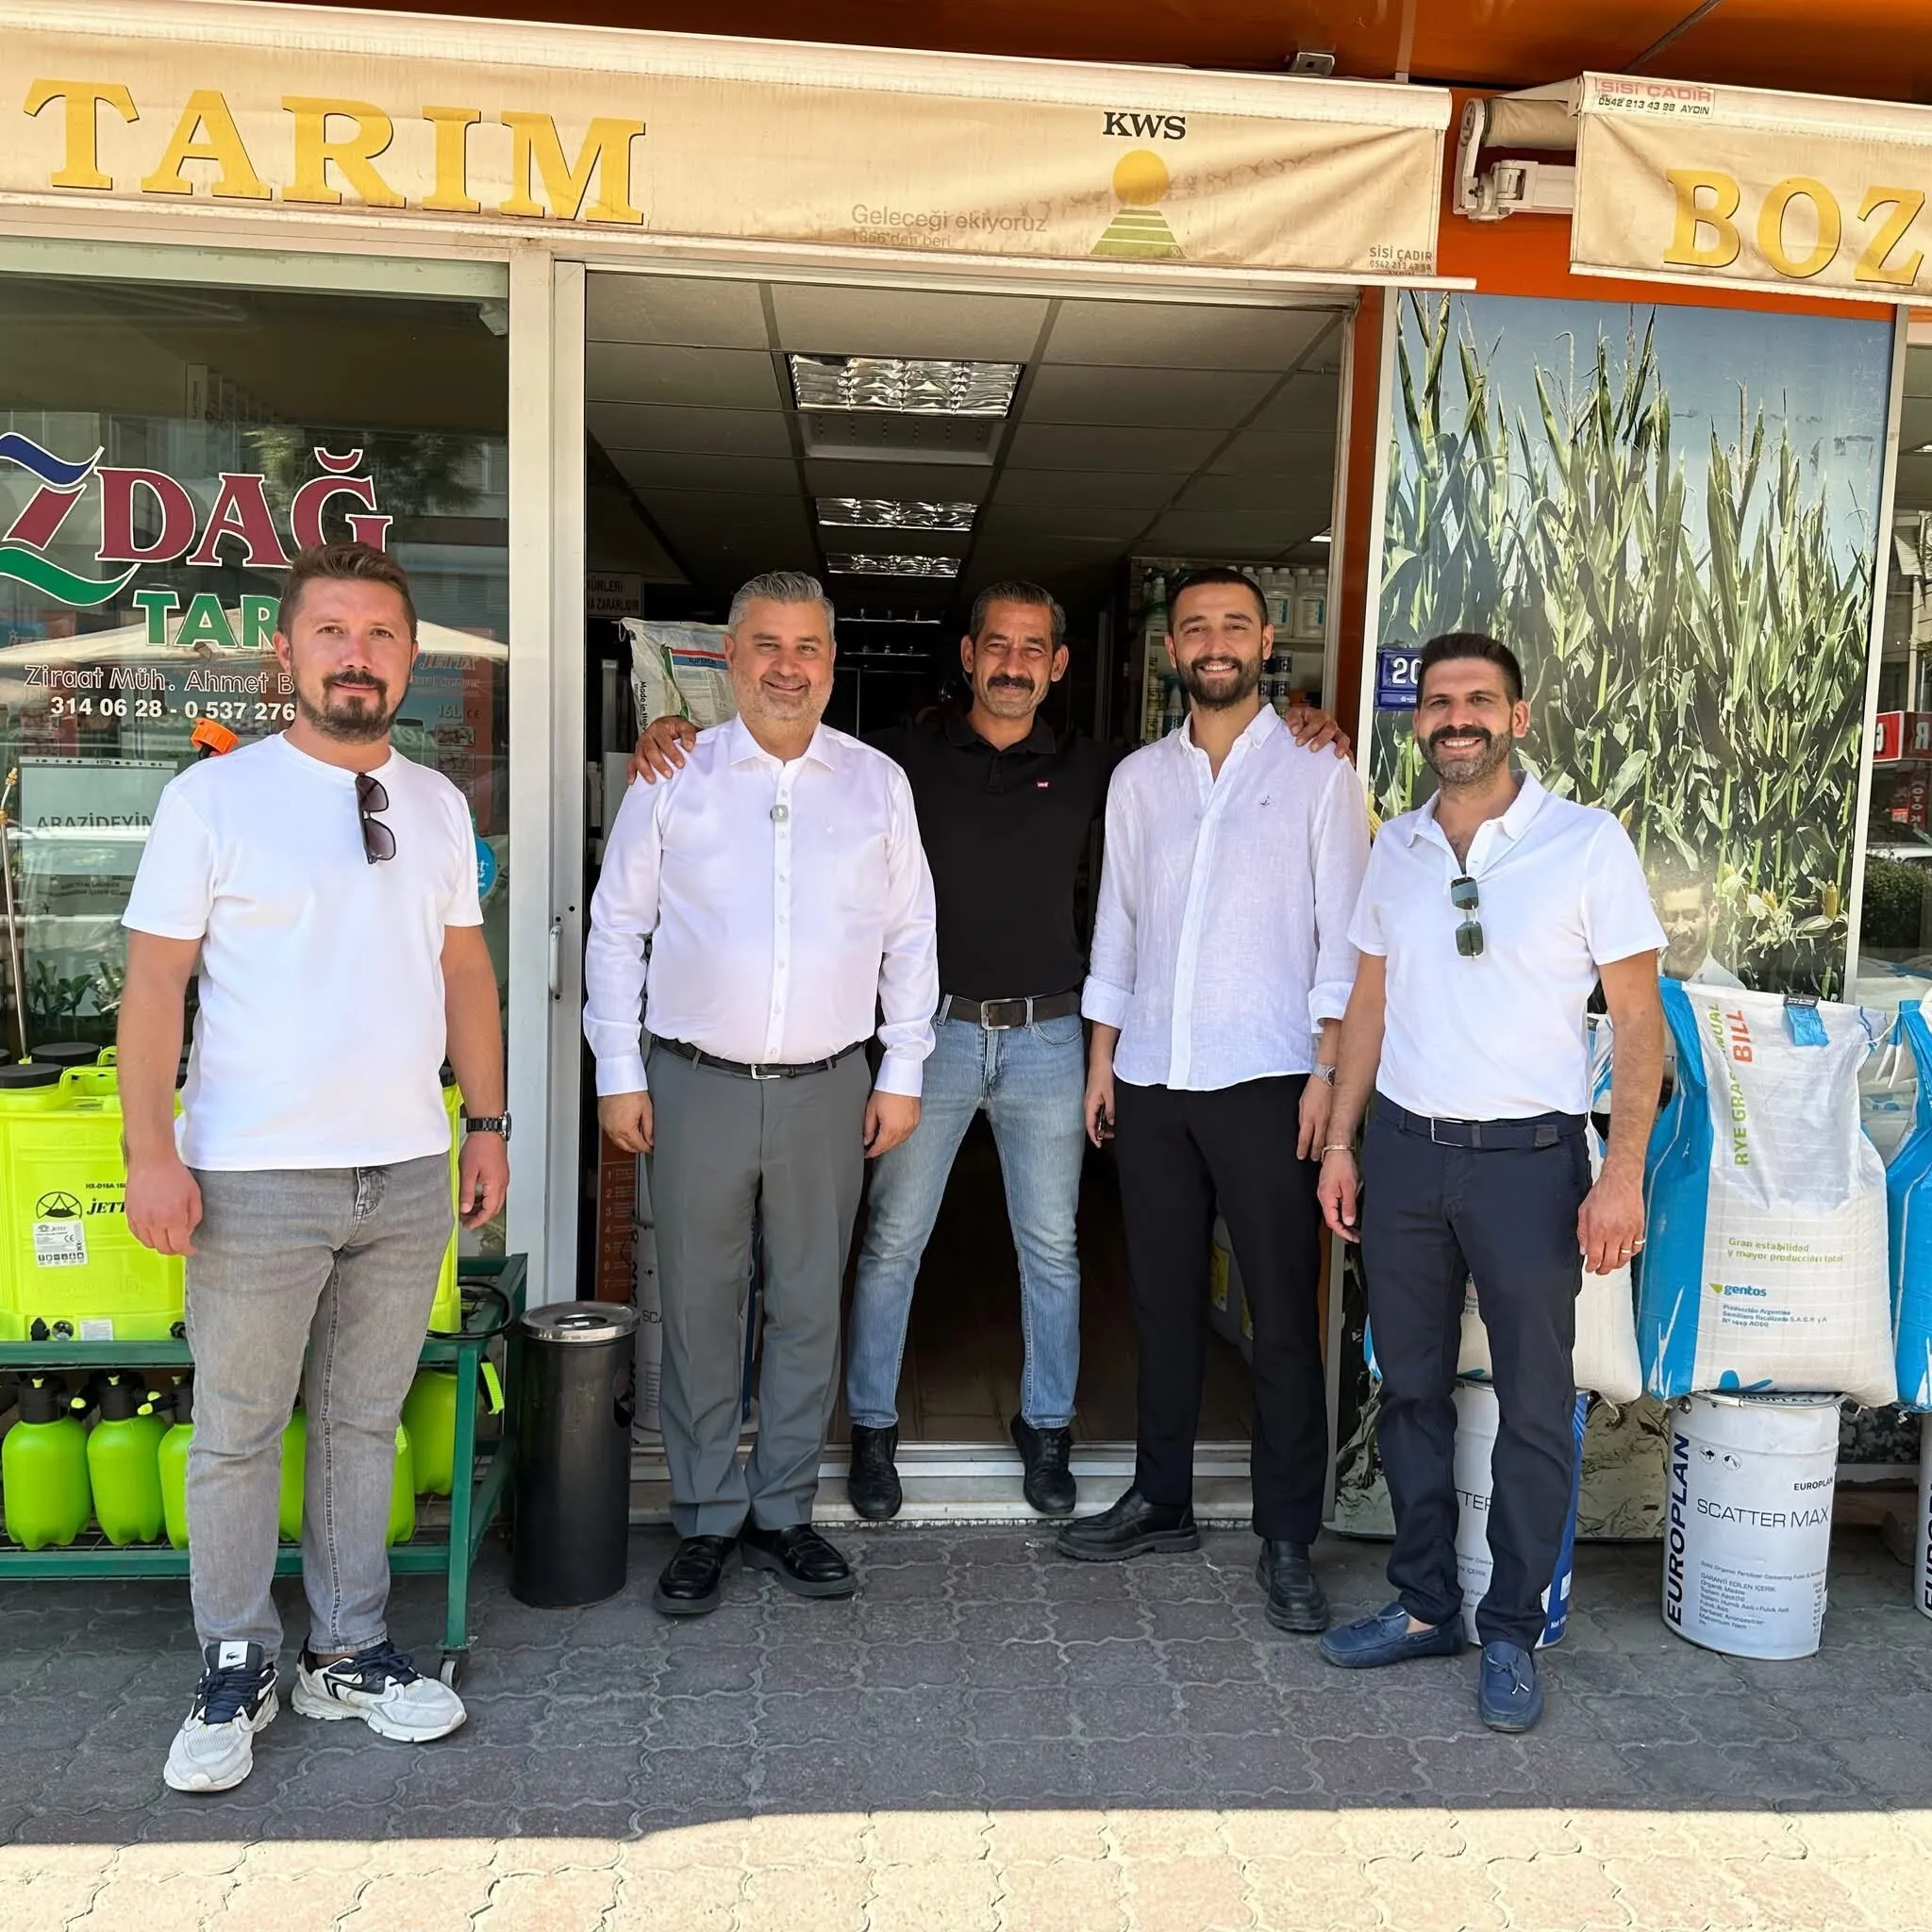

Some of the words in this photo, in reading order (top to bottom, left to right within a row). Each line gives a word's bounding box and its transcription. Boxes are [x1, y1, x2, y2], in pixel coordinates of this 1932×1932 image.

[1625, 100, 1644, 108] 213
[1647, 102, 1660, 110] 43
[1680, 105, 1710, 115] AYDIN
[1103, 111, 1187, 140] KWS
[23, 78, 645, 225] TARIM
[852, 204, 948, 232] Geleceği
[1663, 169, 1925, 286] BOZ
[923, 234, 951, 247] beri
[25, 664, 104, 689] Ziraat
[108, 666, 176, 691] Müh.
[184, 669, 270, 695] Ahmet
[51, 697, 92, 716] 314
[100, 698, 128, 717] 06
[135, 699, 163, 718] 28
[185, 701, 199, 719] 0
[206, 701, 246, 720] 537
[255, 702, 296, 721] 276
[1726, 1009, 1754, 1063] BILL
[1734, 1127, 1749, 1167] RYE
[1736, 1250, 1767, 1261] mayor
[1755, 1241, 1809, 1253] estabilidad
[1724, 1285, 1767, 1297] gentos
[1793, 1475, 1833, 1491] EUROPLAN
[1697, 1498, 1787, 1528] SCATTER
[1790, 1506, 1829, 1528] MAX
[1667, 1432, 1690, 1627] EUROPLAN
